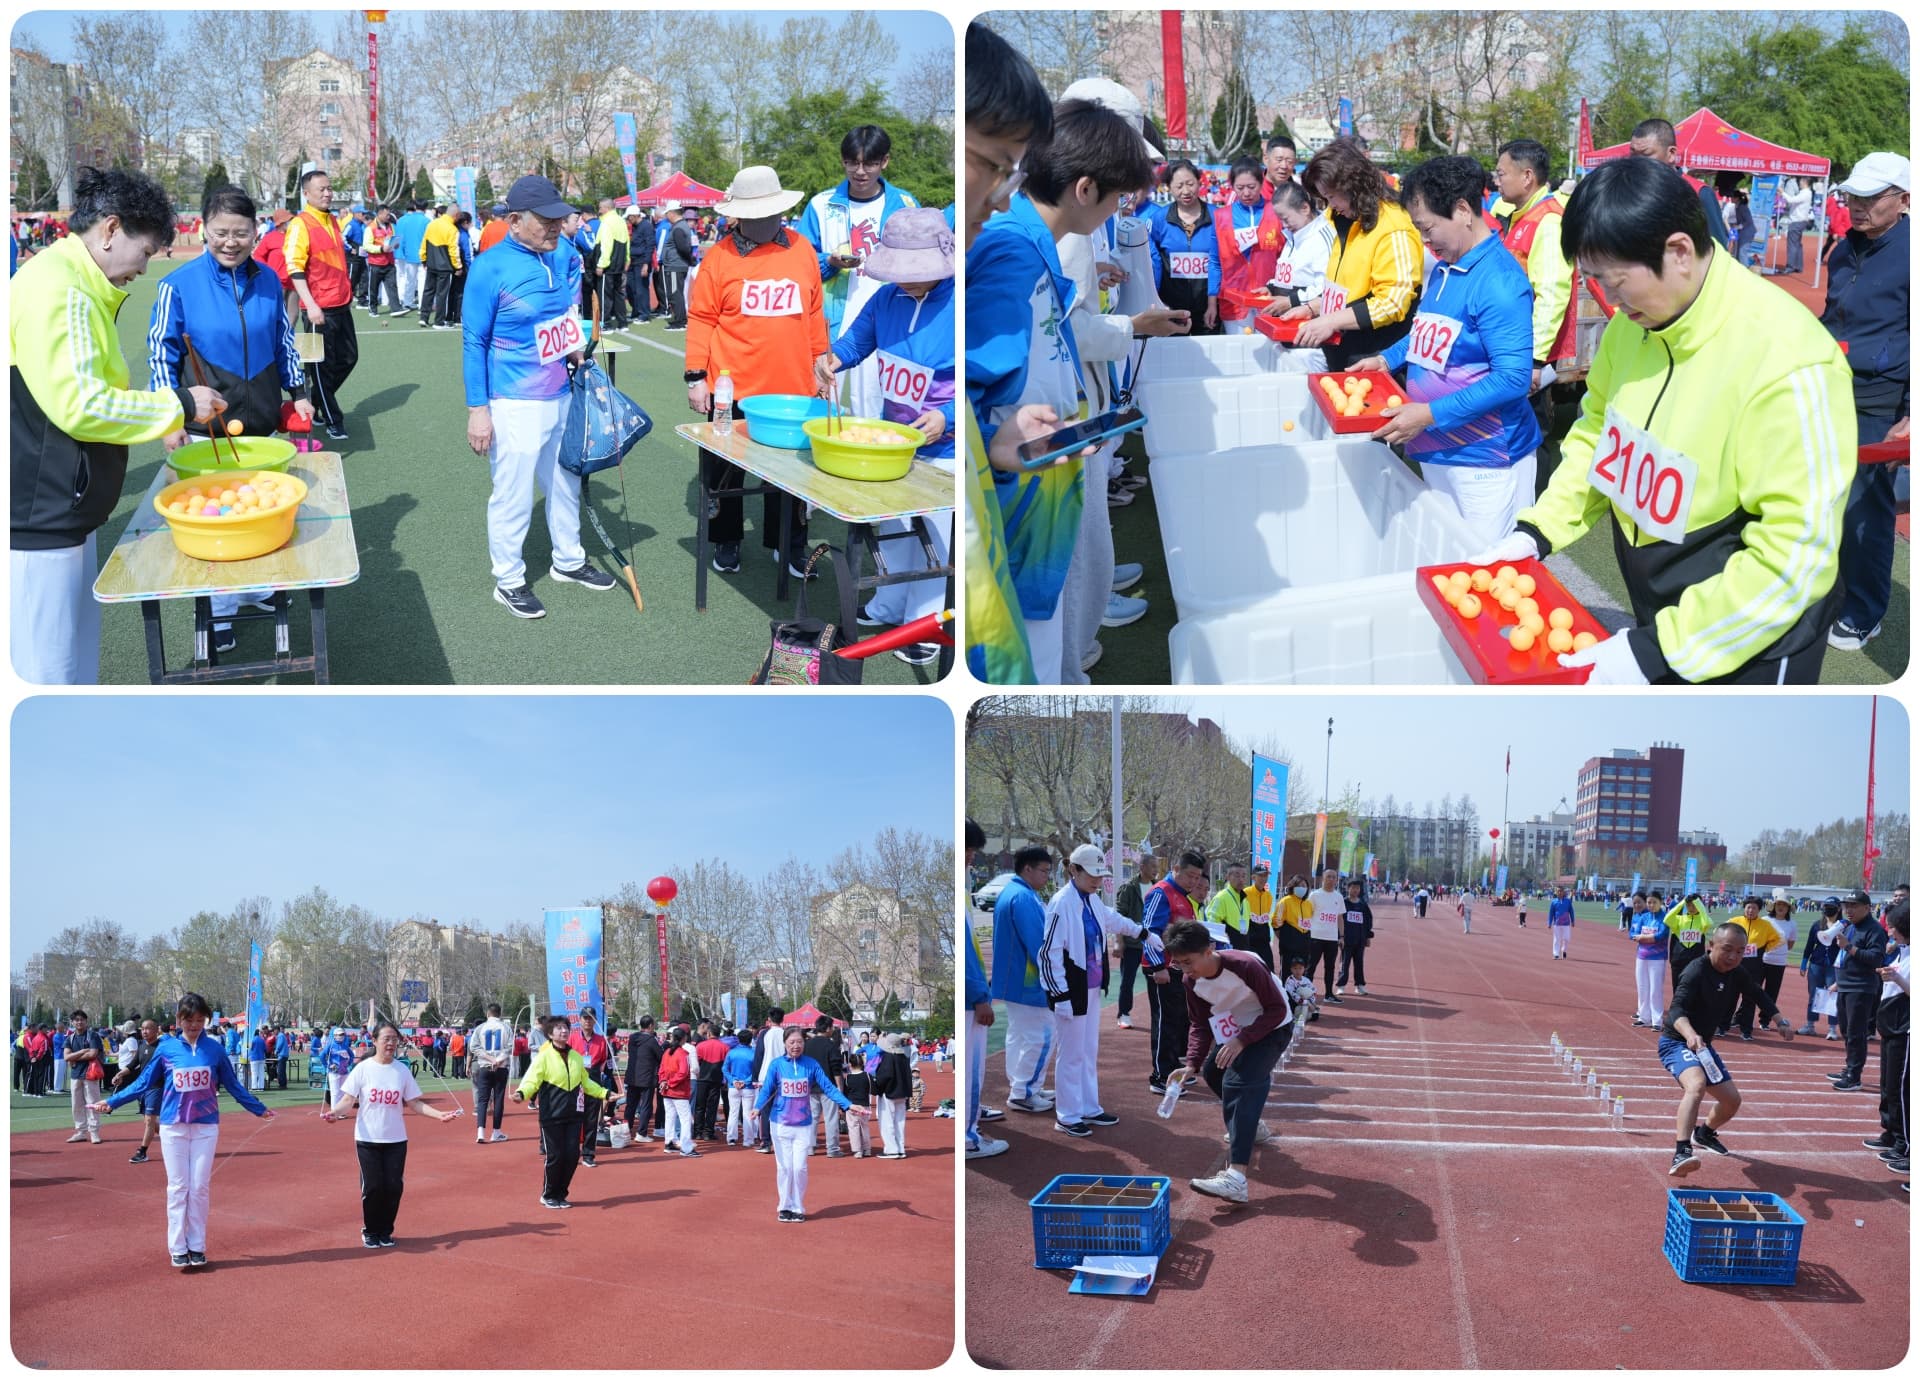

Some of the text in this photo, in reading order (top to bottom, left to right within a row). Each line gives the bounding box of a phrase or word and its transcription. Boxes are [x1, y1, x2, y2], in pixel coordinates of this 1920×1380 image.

[745, 284, 795, 310] 5127
[538, 317, 580, 358] 2029
[1594, 426, 1683, 525] 2100
[1681, 930, 1700, 940] 1201
[175, 1070, 210, 1089] 3193
[369, 1088, 400, 1105] 3192
